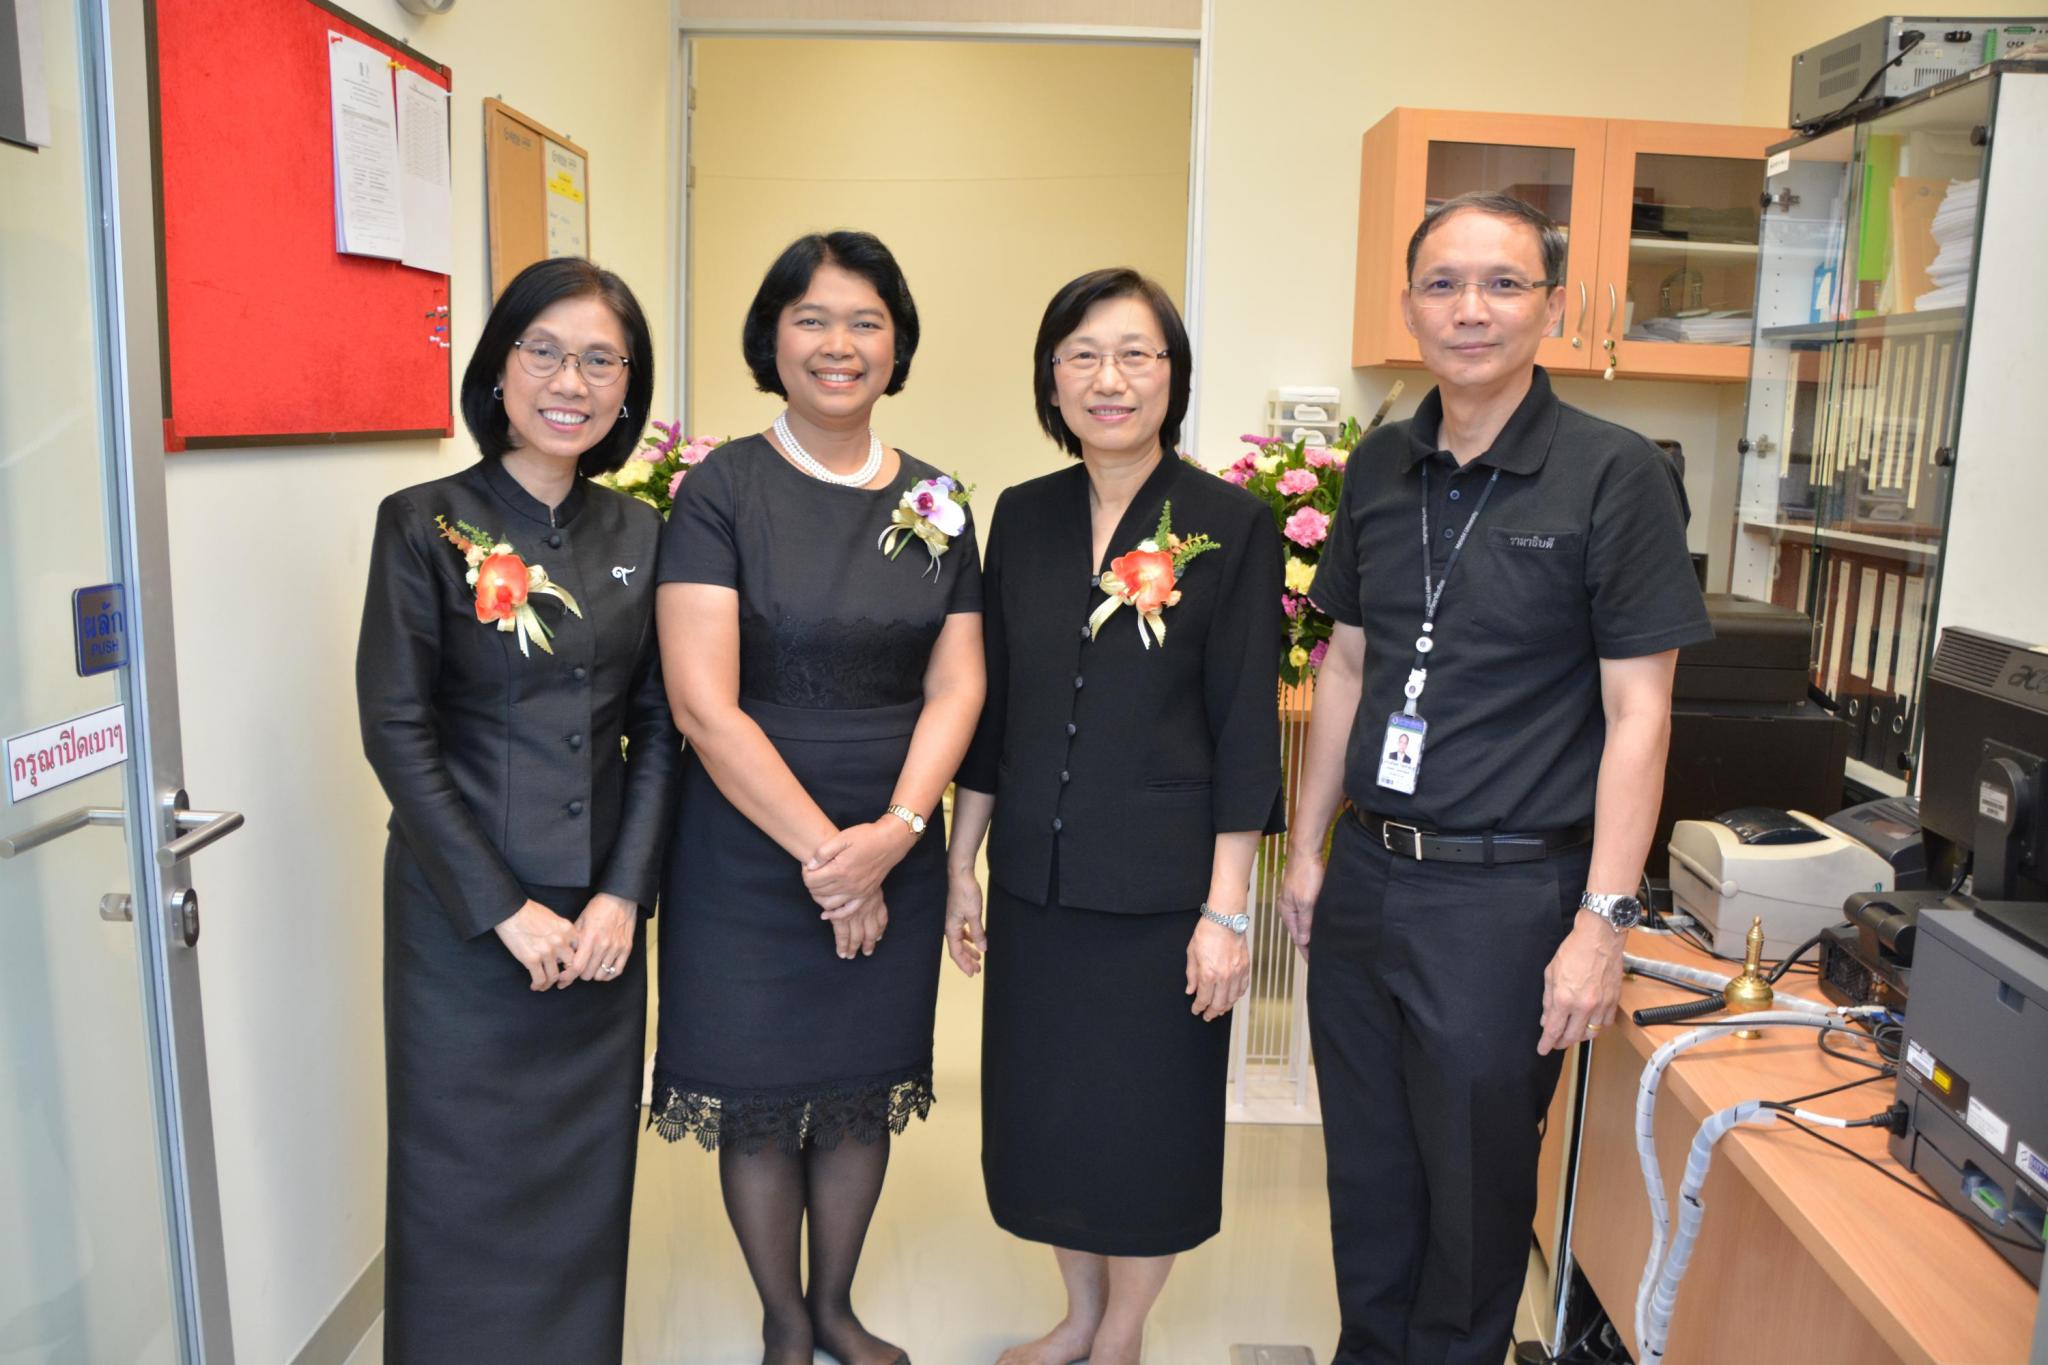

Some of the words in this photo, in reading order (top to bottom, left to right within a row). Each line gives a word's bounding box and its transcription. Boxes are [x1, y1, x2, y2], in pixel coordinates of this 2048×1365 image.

[1509, 535, 1556, 550] รามาธิบดี
[91, 640, 119, 656] PUSH
[13, 724, 124, 787] กรุณาปิดเบาๆ
